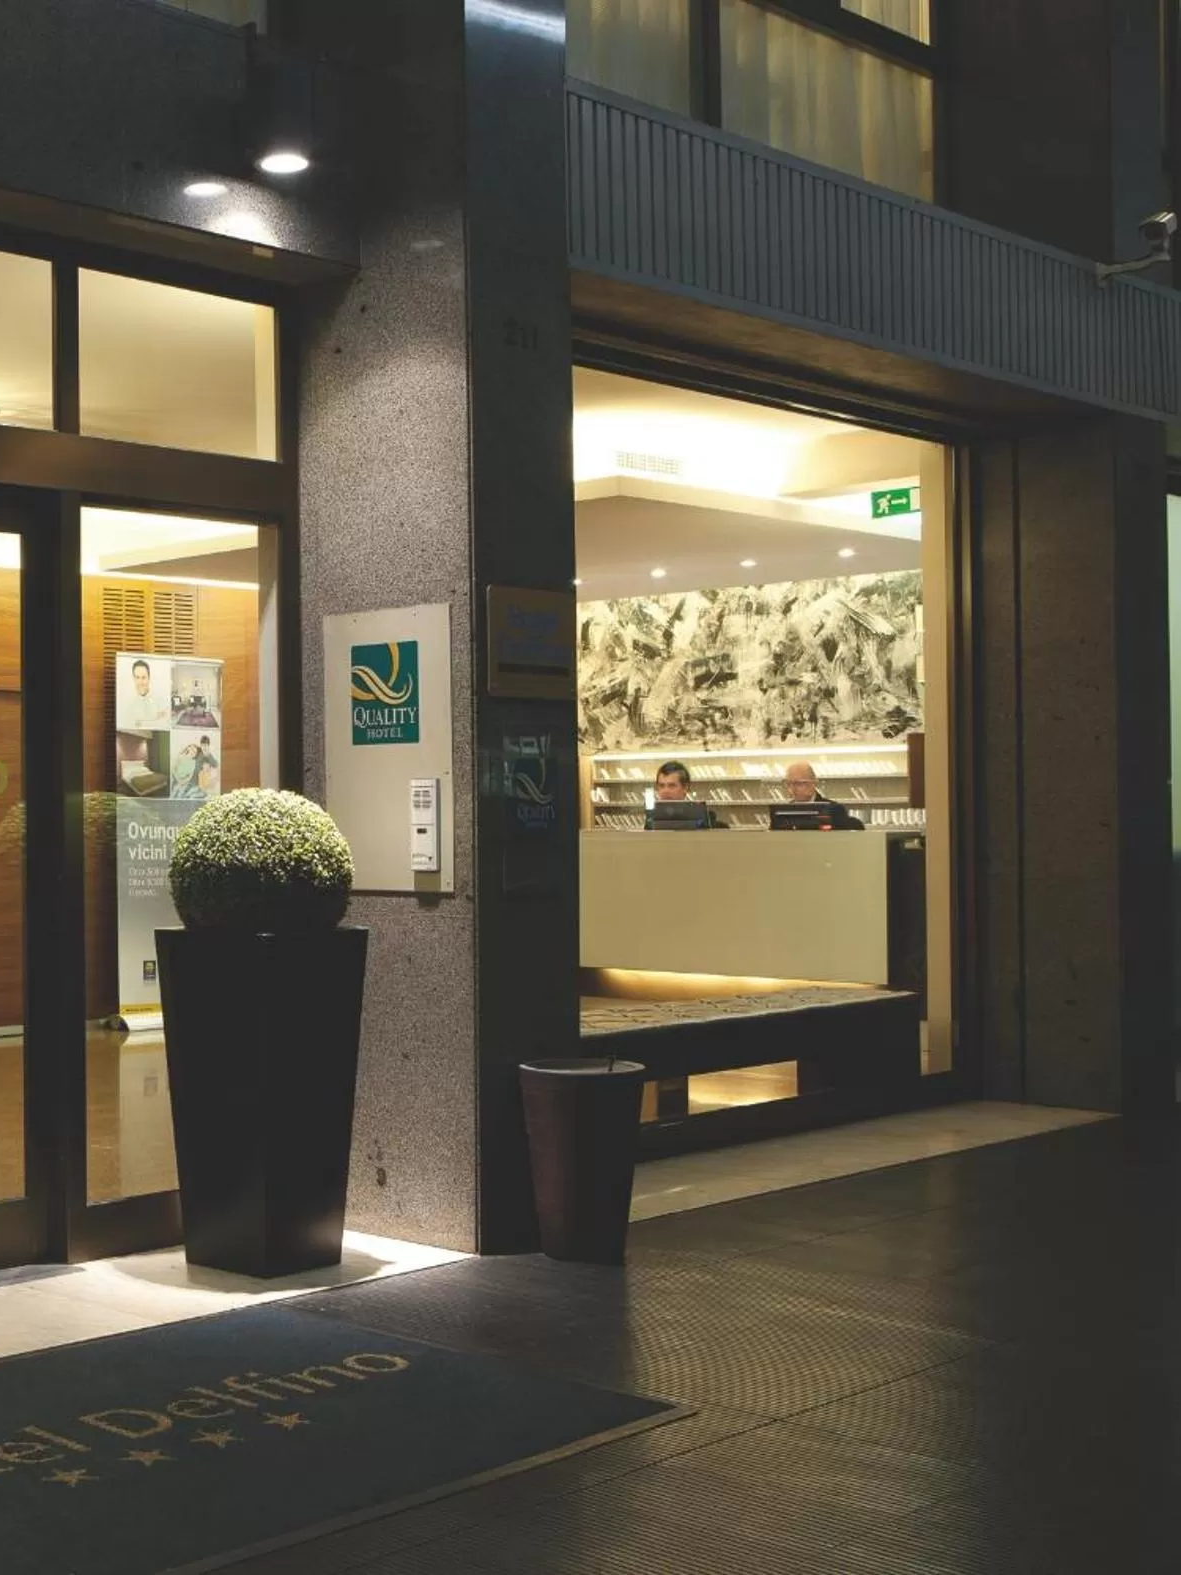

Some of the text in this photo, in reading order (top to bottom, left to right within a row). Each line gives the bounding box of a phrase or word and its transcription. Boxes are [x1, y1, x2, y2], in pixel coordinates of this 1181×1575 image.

[353, 706, 417, 729] QUALITY
[367, 727, 404, 739] HOTEL
[128, 843, 168, 861] vicini
[78, 1352, 411, 1439] Delfino
